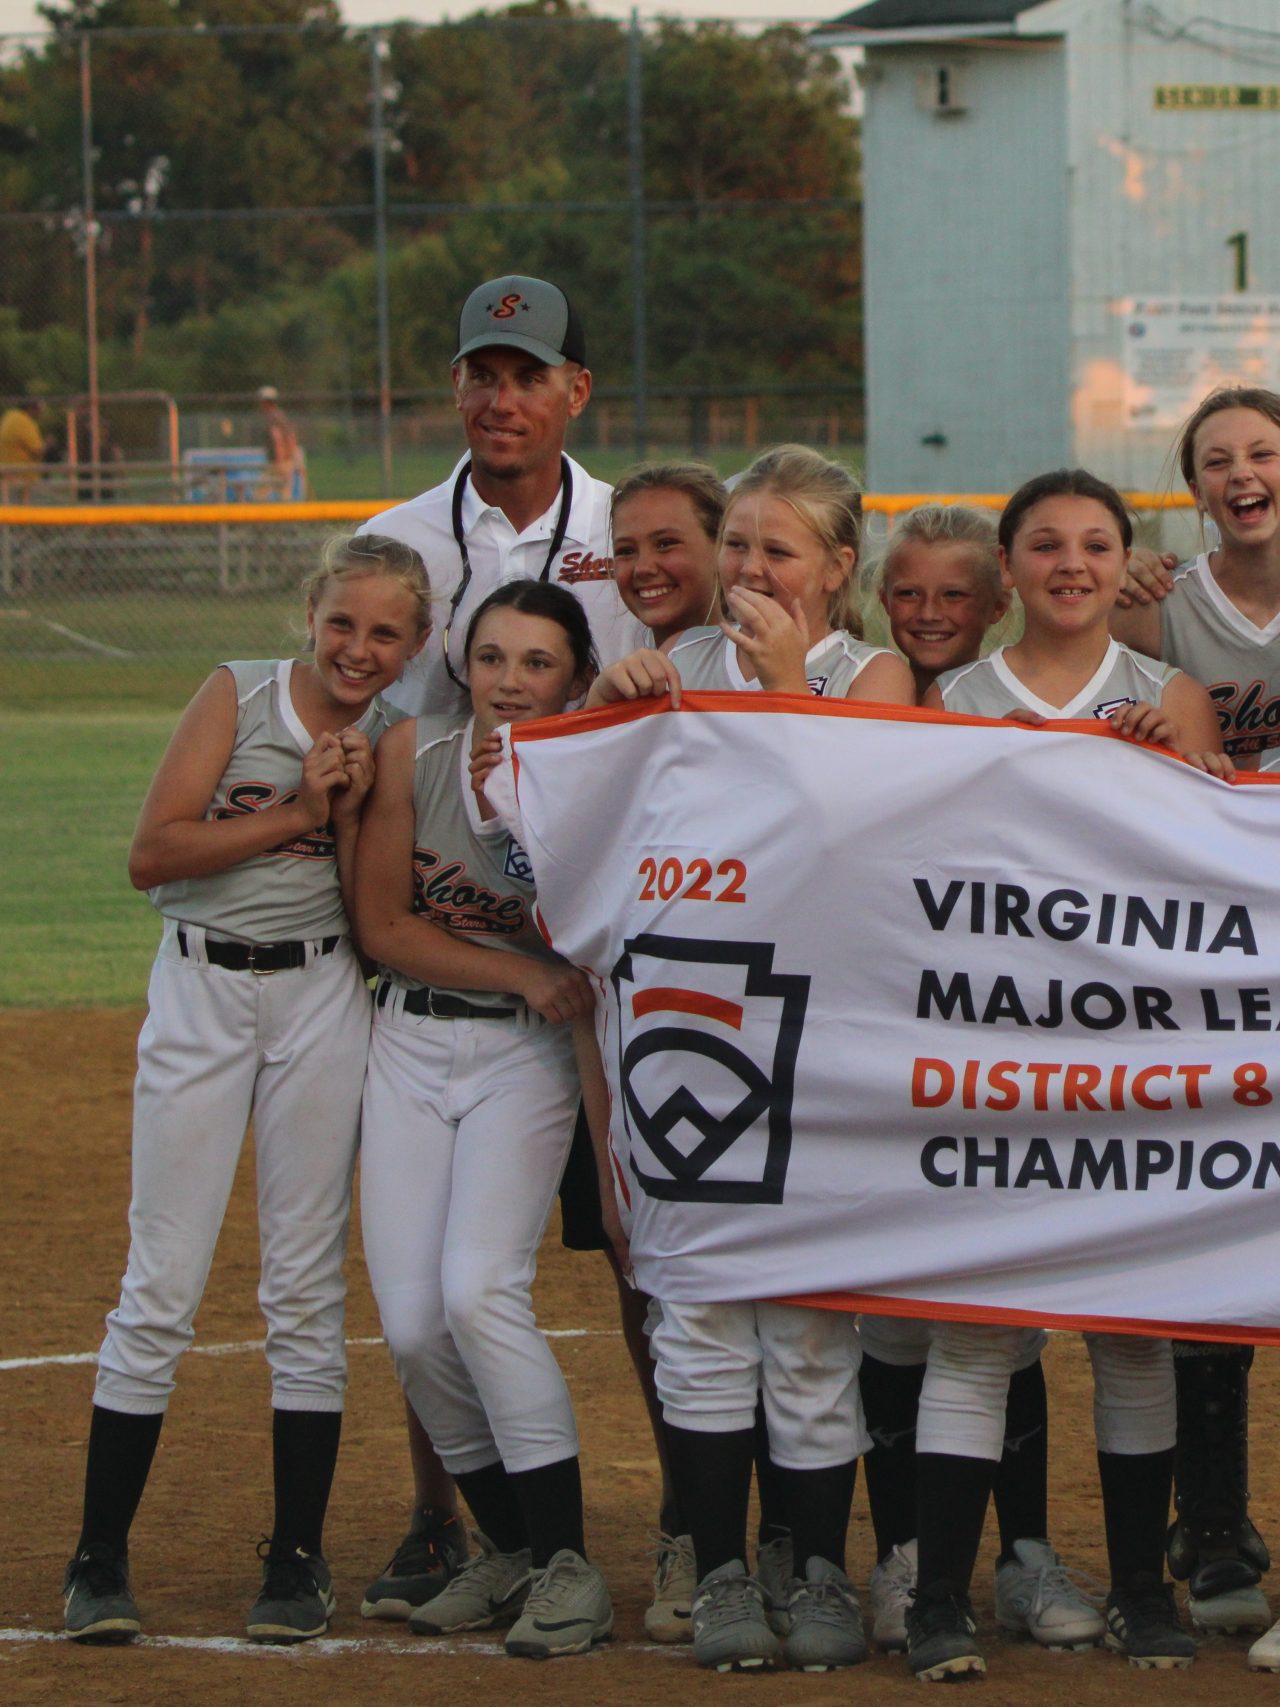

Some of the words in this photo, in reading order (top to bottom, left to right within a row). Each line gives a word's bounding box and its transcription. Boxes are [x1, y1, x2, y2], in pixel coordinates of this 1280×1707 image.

[1225, 231, 1249, 293] 1
[492, 293, 522, 319] S
[559, 551, 615, 575] Shor
[638, 856, 748, 903] 2022
[912, 878, 1259, 956] VIRGINIA
[916, 969, 1181, 1031] MAJOR
[911, 1057, 1212, 1112] DISTRICT
[1232, 1062, 1273, 1107] 8
